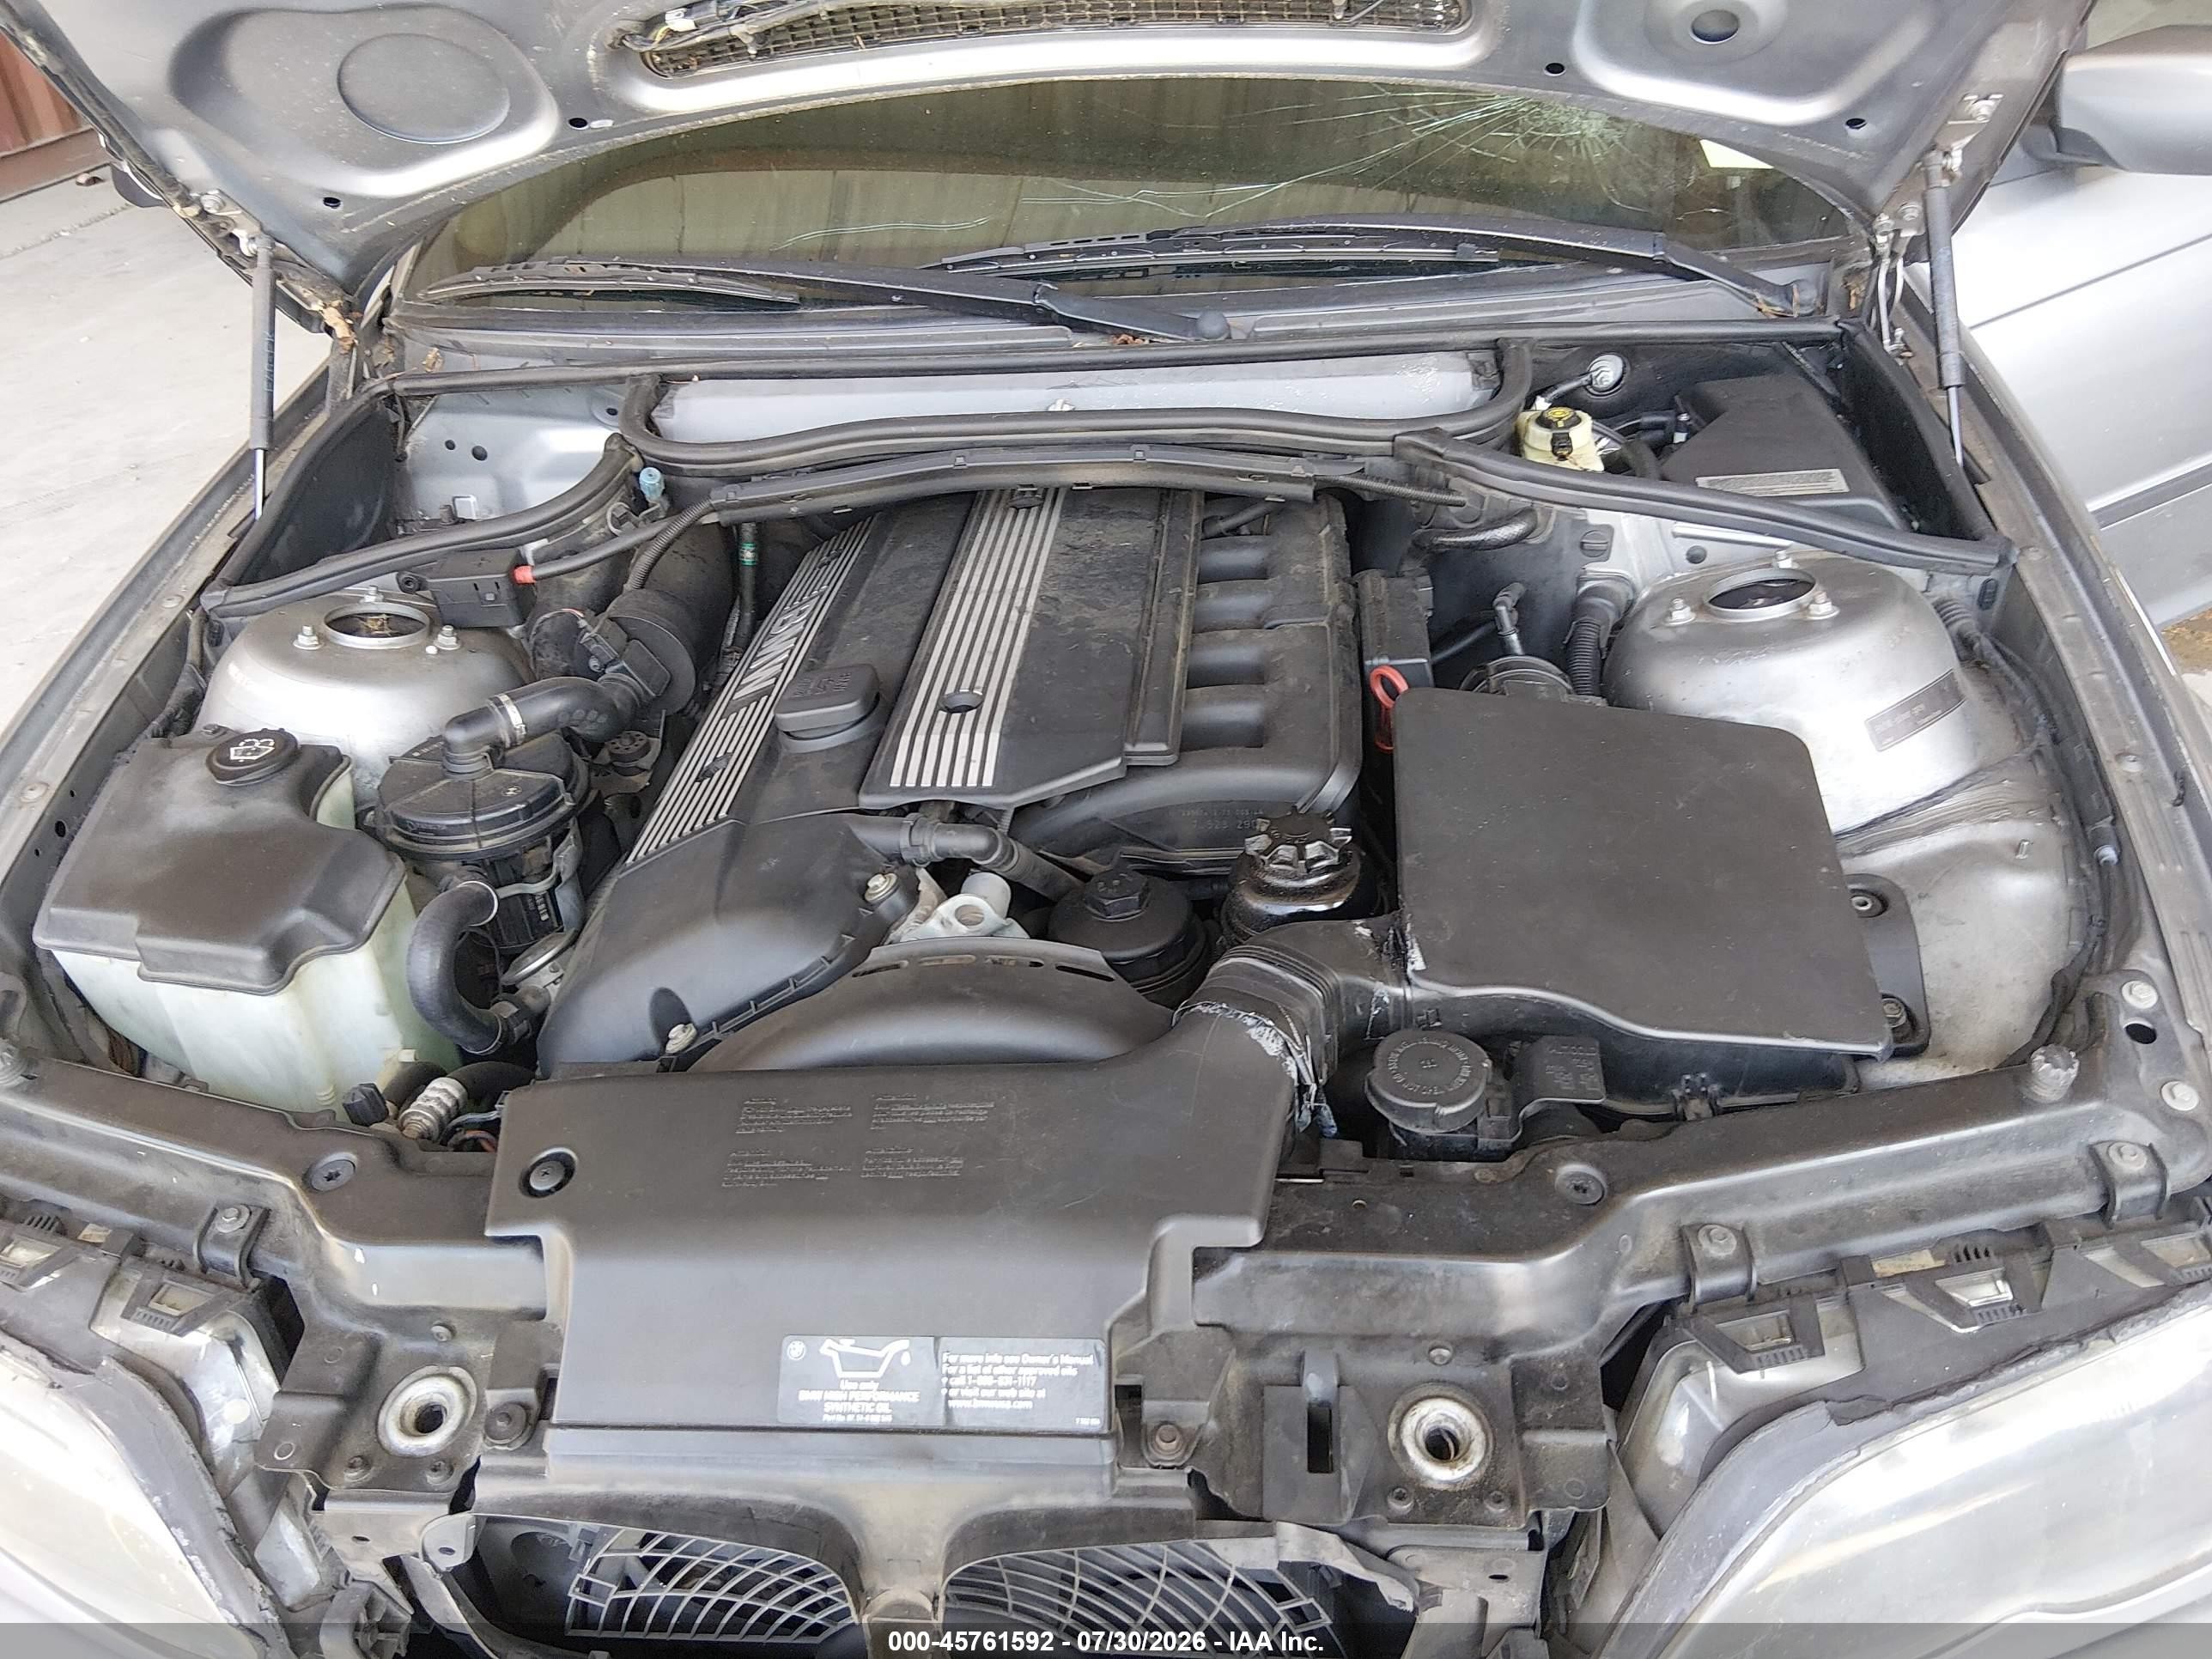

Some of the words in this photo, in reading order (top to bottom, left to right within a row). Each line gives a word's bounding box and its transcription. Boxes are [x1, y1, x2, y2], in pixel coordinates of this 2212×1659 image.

[942, 1352, 958, 1364] For
[942, 1364, 957, 1375] For
[949, 1376, 966, 1386] call
[848, 1390, 921, 1402] PERFORMANCE
[823, 1401, 874, 1413] SYNTHETIC
